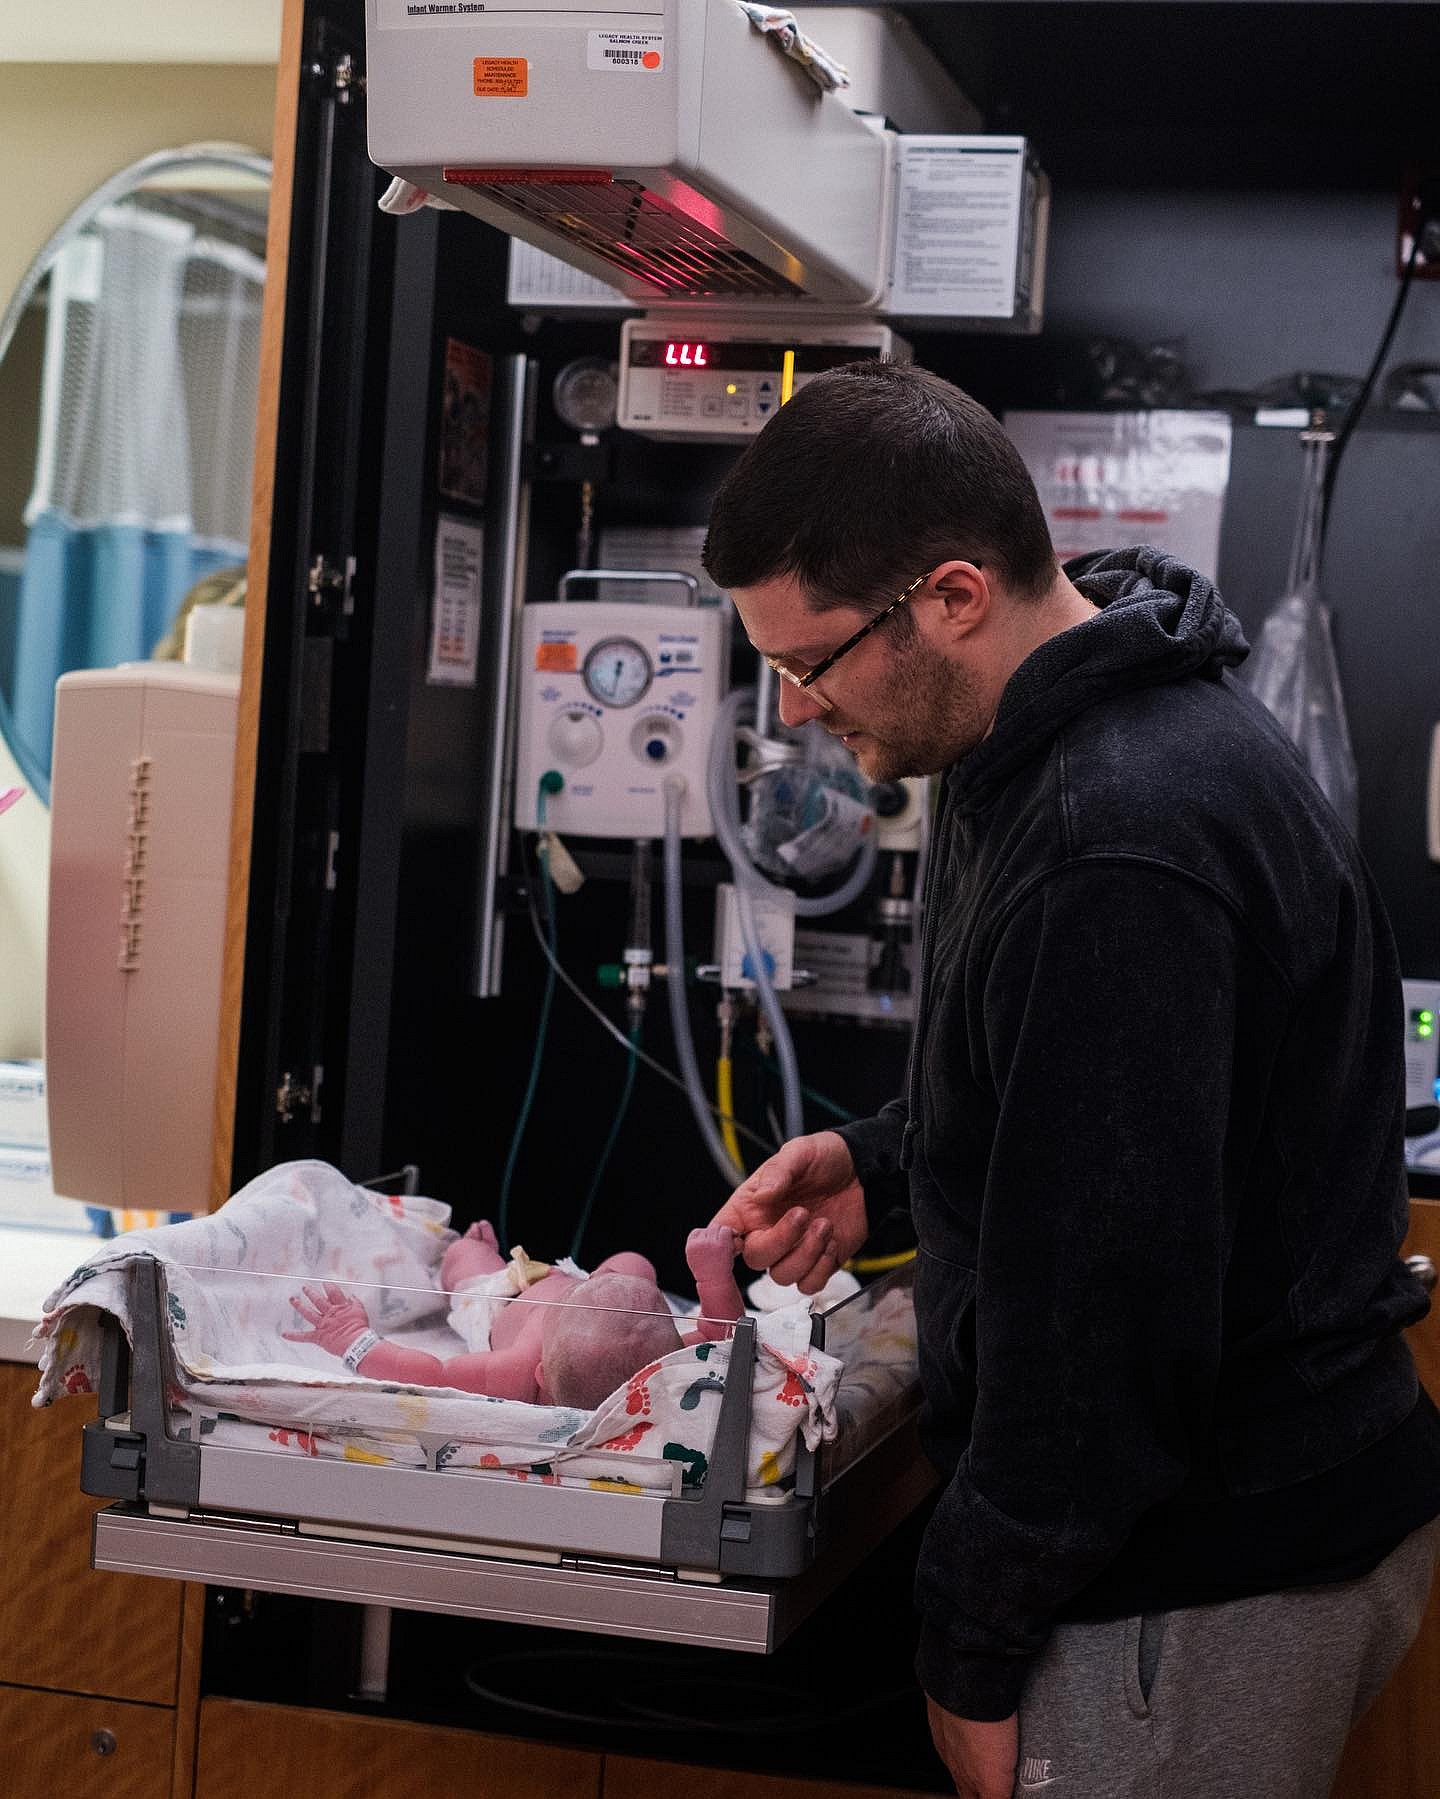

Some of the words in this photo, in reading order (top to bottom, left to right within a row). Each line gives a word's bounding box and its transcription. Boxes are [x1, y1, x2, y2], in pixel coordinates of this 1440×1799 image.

[408, 5, 427, 14] Infant
[429, 4, 456, 13] Warmer
[458, 3, 485, 13] System
[1023, 1757, 1051, 1780] NIKE
